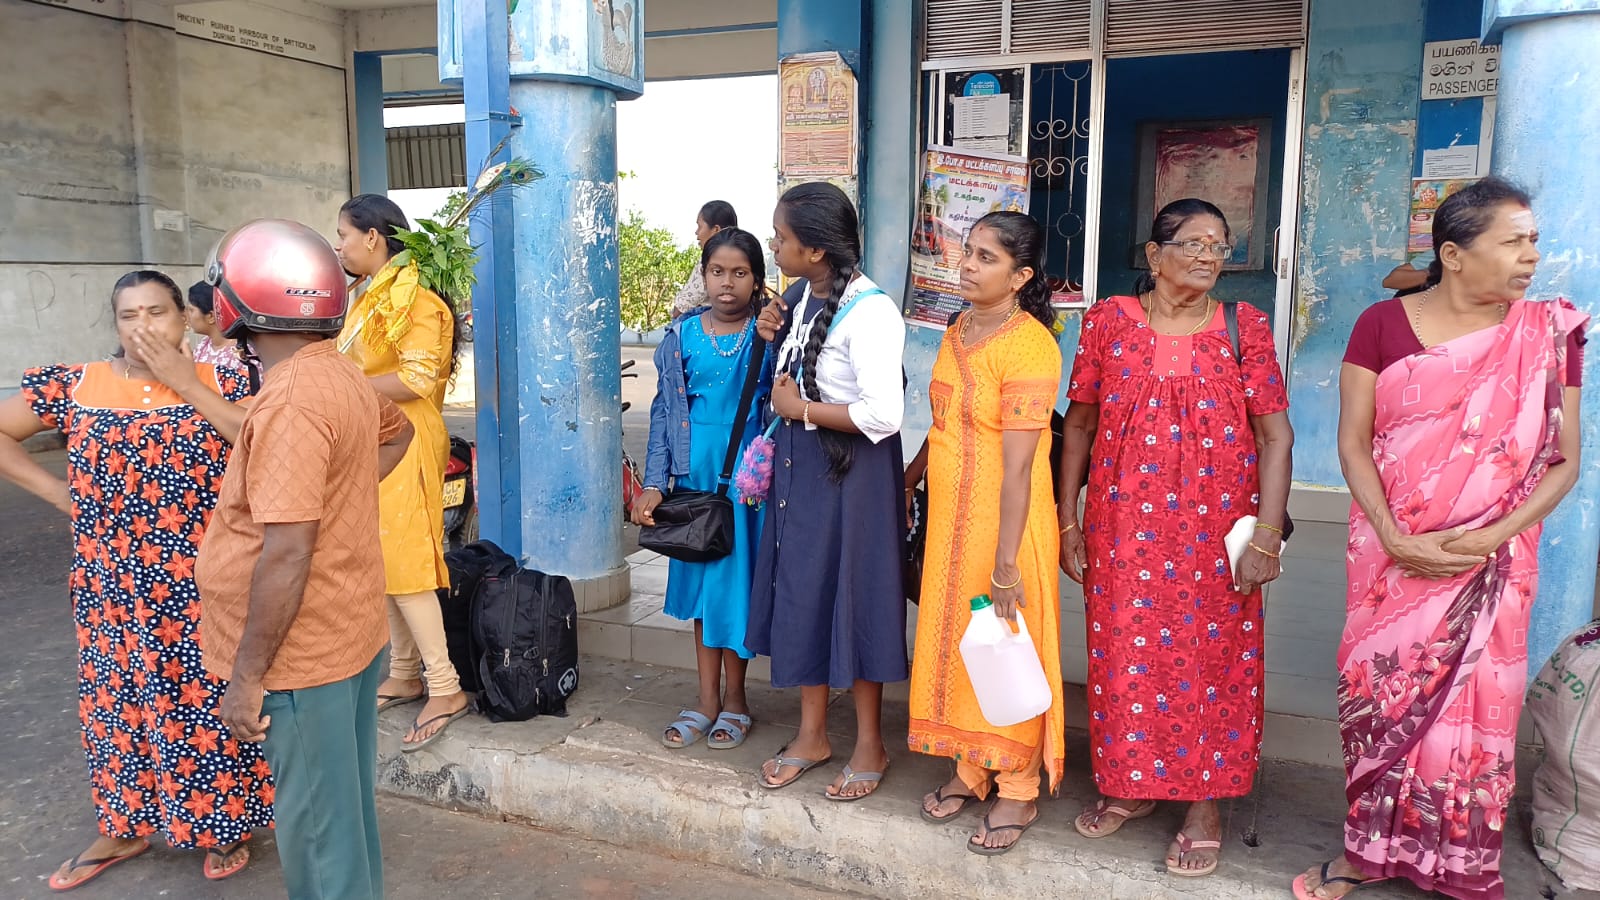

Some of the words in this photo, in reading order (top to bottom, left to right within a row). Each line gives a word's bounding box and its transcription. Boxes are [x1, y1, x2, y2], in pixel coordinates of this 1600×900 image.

[177, 12, 205, 26] ANCIENT
[210, 20, 235, 33] RUINED
[271, 35, 280, 43] OF
[212, 31, 236, 43] DURING
[263, 42, 284, 53] PERIOD
